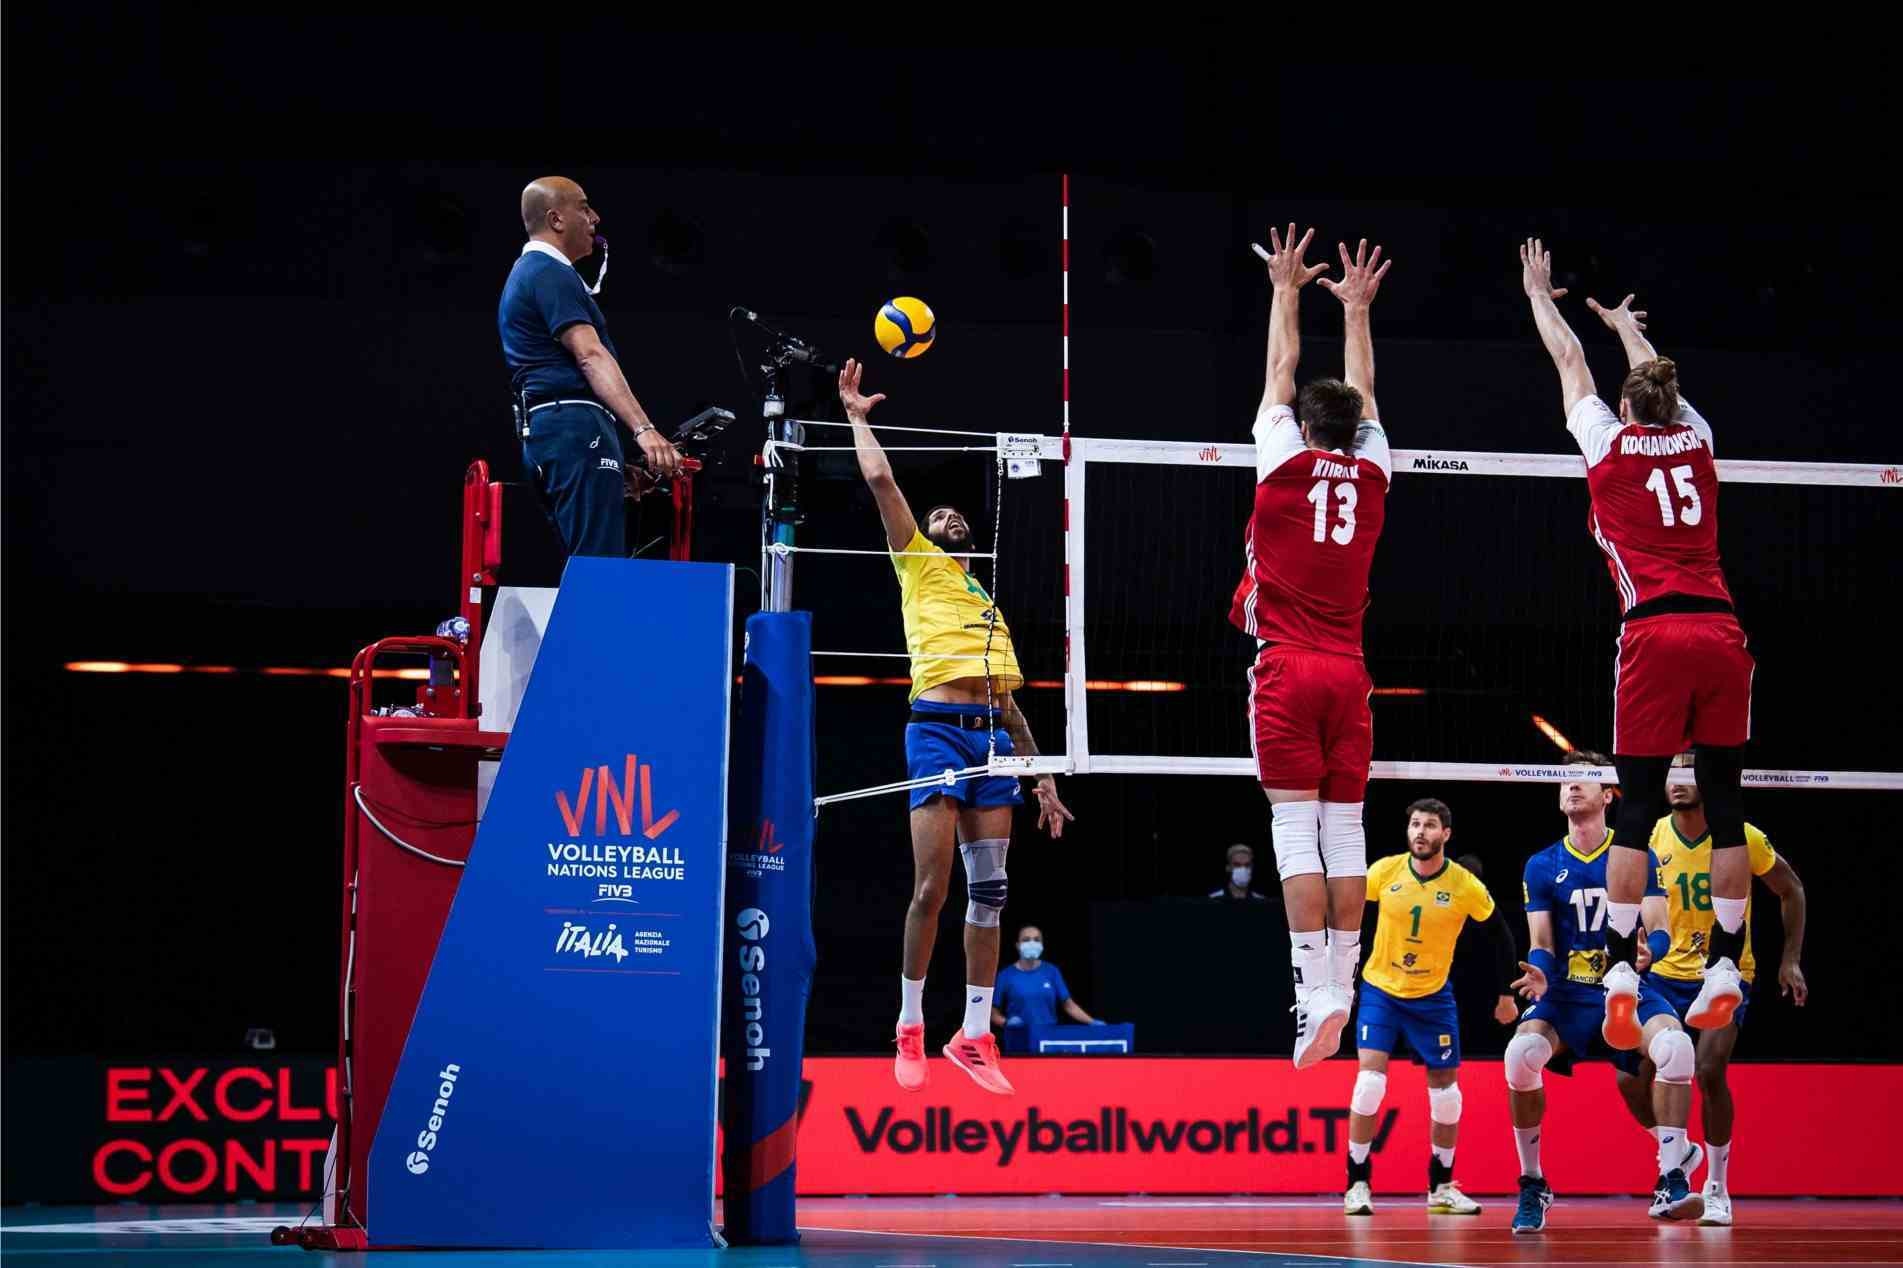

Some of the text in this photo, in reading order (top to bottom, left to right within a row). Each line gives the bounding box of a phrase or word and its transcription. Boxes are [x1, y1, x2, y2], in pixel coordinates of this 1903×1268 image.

[1198, 445, 1222, 462] VNL
[1621, 430, 1702, 457] KOCHANOWSK
[1412, 455, 1469, 471] MIKASA
[1645, 465, 1701, 527] 15
[1306, 479, 1358, 546] 13
[1515, 768, 1567, 778] VOLLEYBALL
[1743, 773, 1794, 783] VOLLEYBALL
[555, 753, 681, 840] VNL
[547, 843, 685, 865] VOLLEYBALL
[547, 863, 685, 880] NATIONS LEAGUE
[1675, 872, 1713, 912] 18
[1410, 905, 1422, 937] 1
[1569, 887, 1607, 932] 17
[739, 945, 770, 1071] Senoh
[1361, 1025, 1368, 1041] 1
[417, 1064, 461, 1151] Senoh
